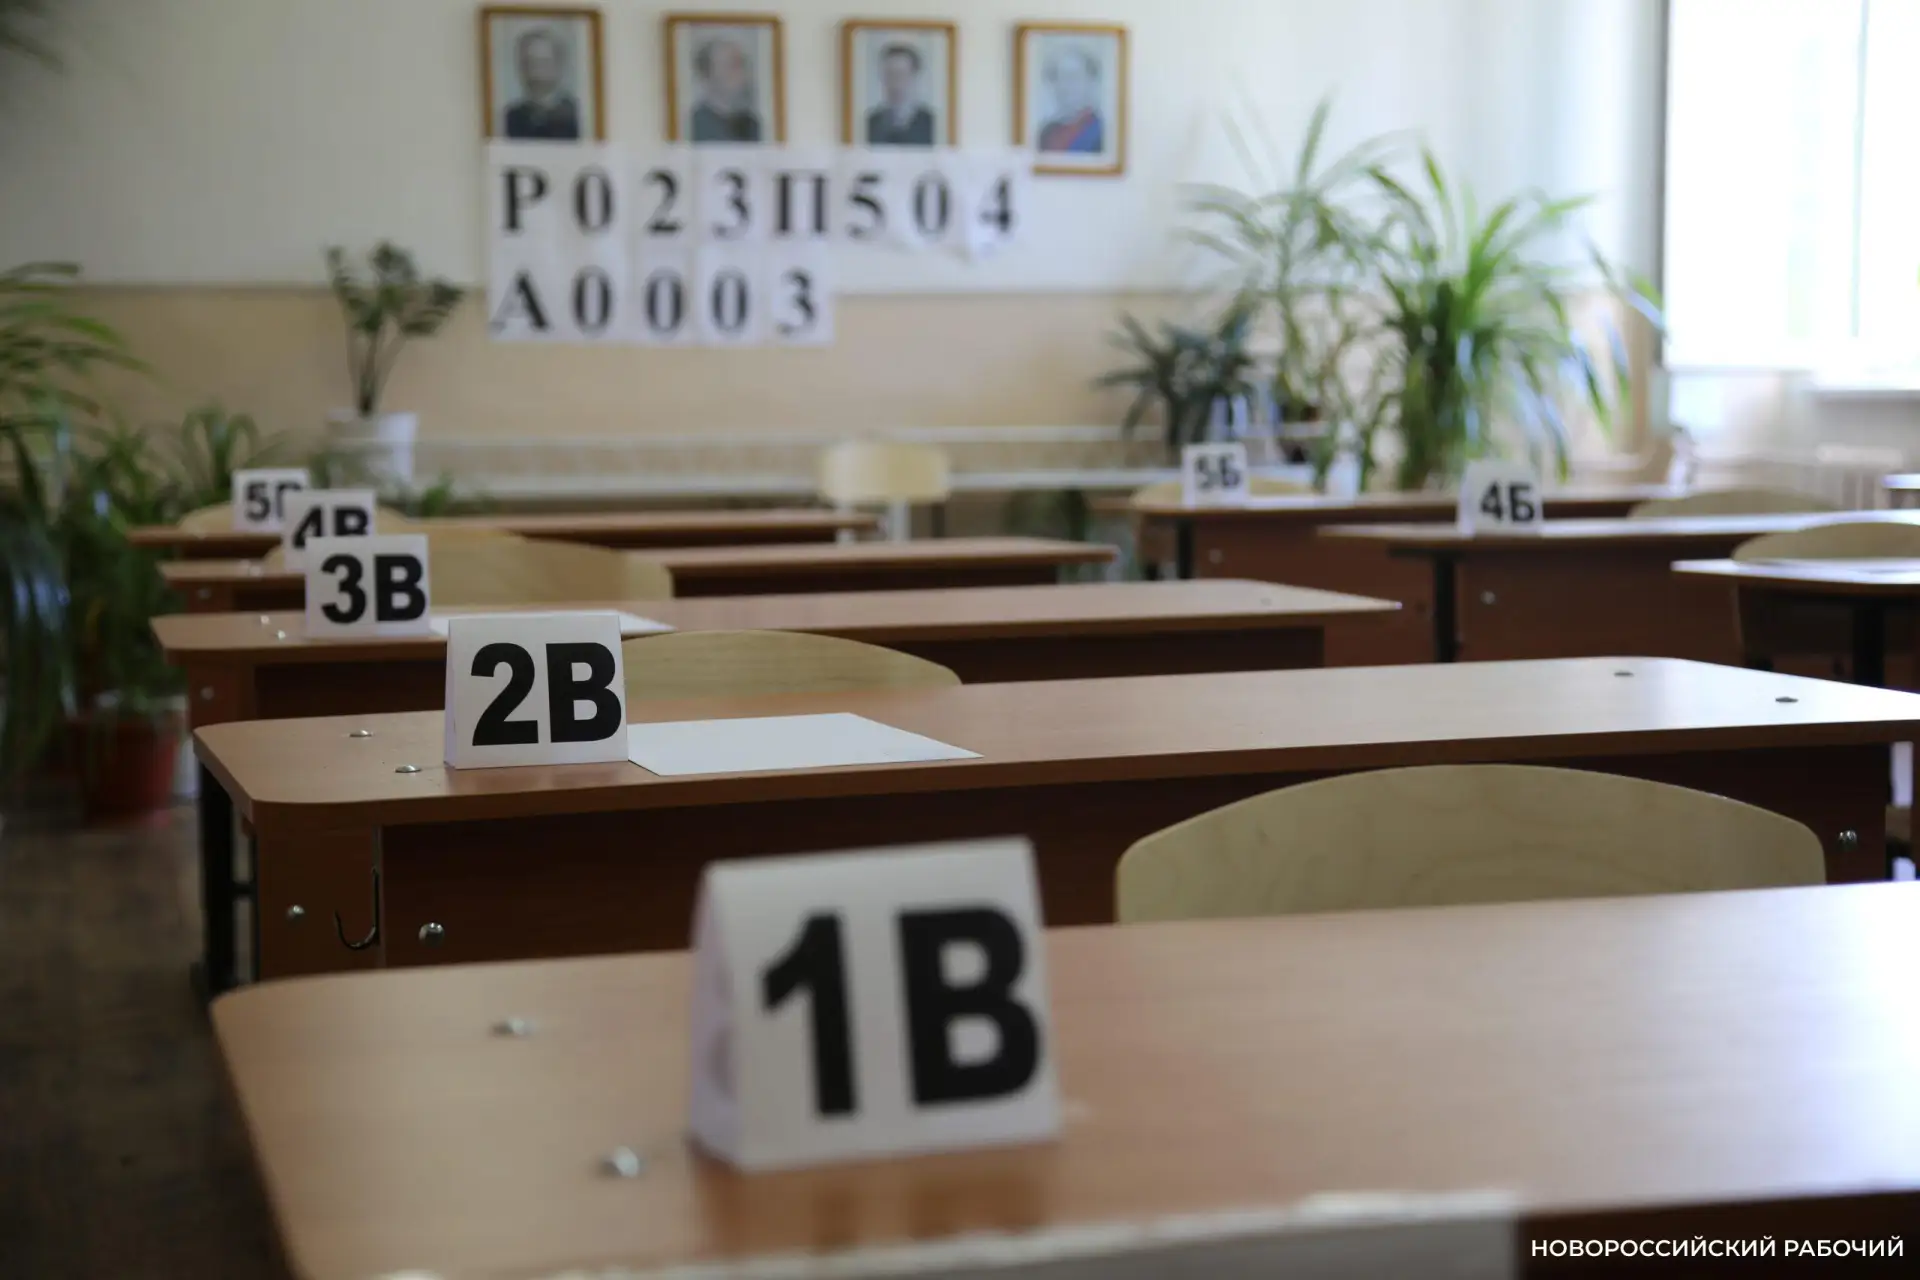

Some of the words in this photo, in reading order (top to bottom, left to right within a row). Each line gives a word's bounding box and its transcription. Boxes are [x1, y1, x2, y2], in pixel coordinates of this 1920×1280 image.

[501, 166, 1016, 238] Р023П504
[491, 267, 816, 336] А0003
[1194, 455, 1241, 489] 5Б
[1479, 480, 1536, 524] 4Б
[321, 554, 426, 624] 3В
[471, 642, 622, 746] 2В
[760, 903, 1043, 1118] 1В
